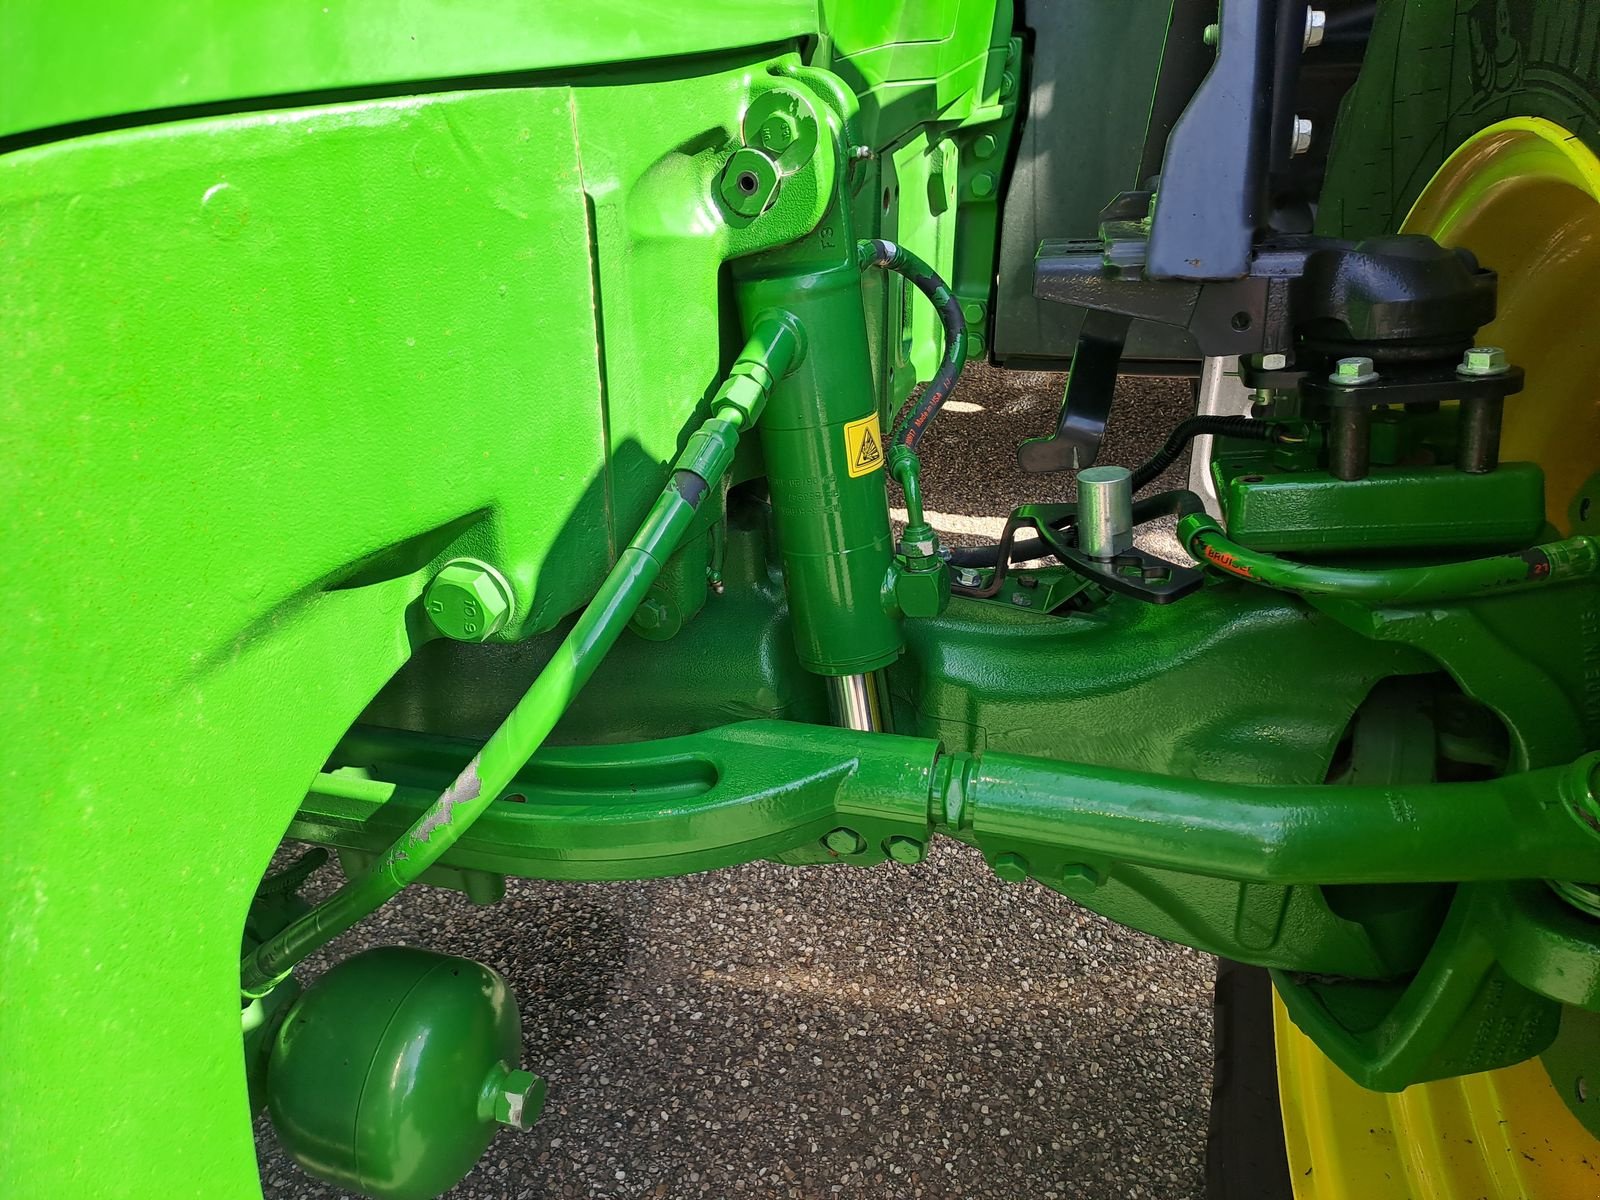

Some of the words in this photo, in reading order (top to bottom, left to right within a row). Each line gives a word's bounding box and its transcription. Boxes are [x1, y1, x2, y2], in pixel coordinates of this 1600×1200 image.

[914, 411, 929, 428] Made
[929, 392, 943, 406] USA
[463, 600, 478, 635] 10.9
